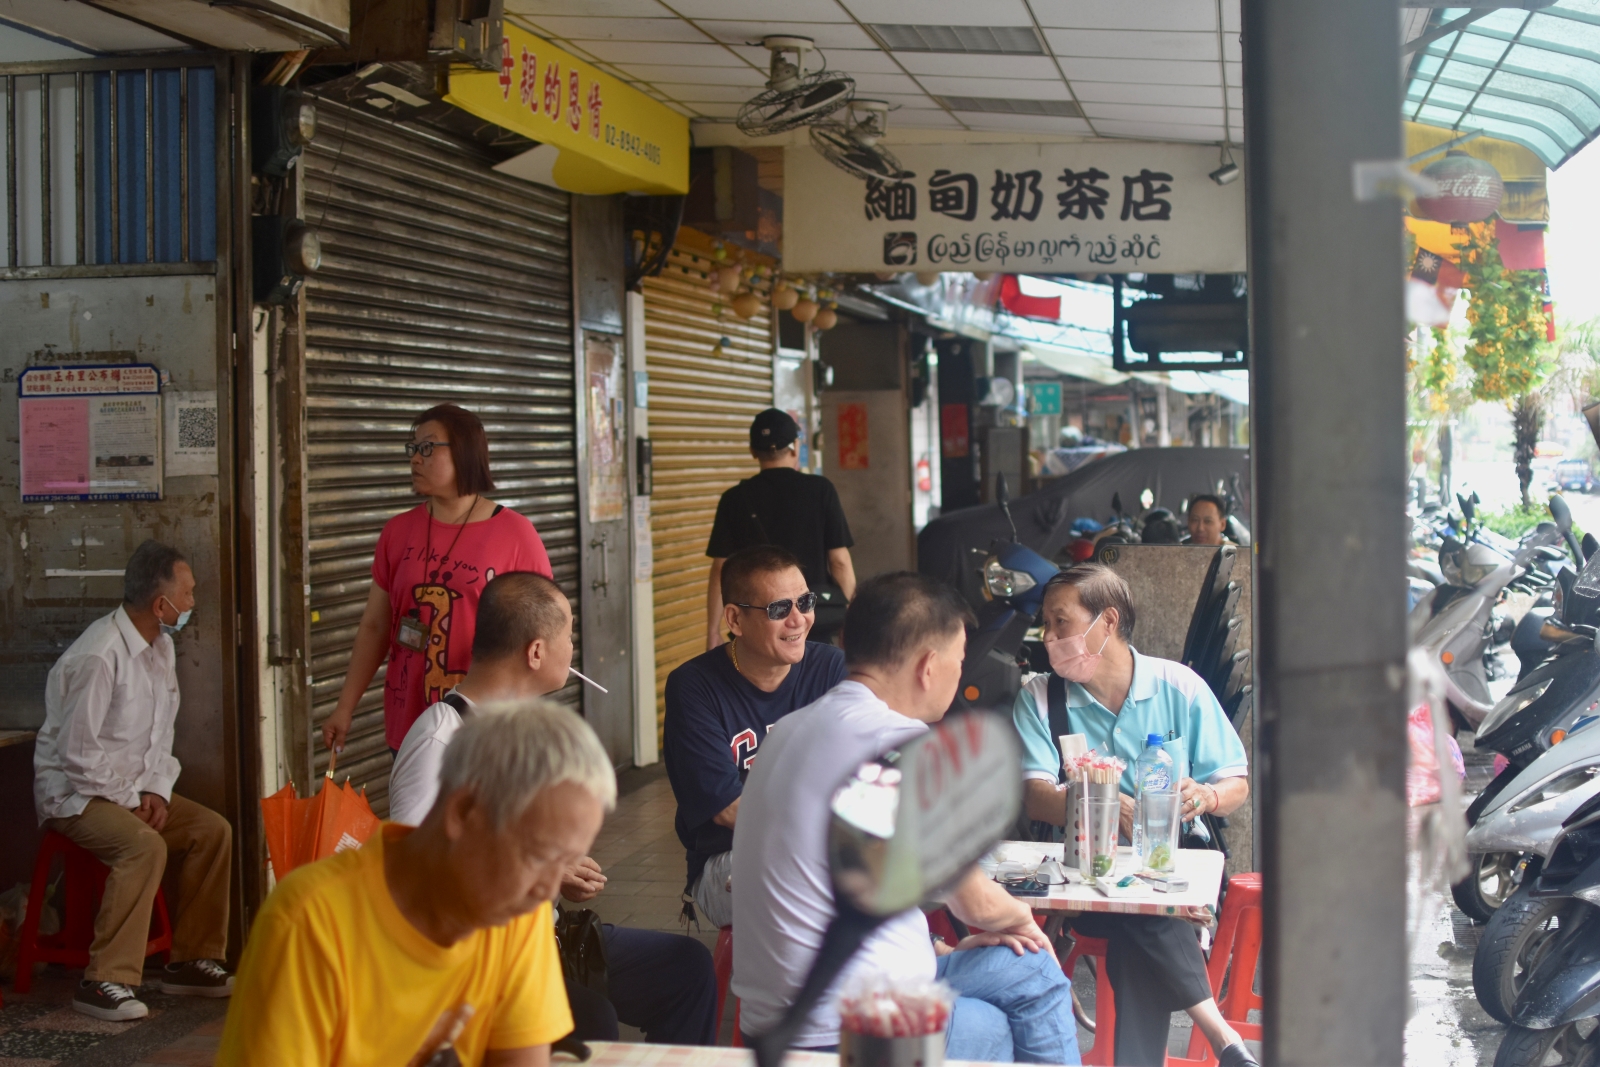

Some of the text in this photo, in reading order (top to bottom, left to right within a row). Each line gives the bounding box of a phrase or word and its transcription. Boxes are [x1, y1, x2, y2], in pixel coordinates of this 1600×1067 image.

[499, 36, 602, 140] 母親的恩情
[864, 167, 1173, 222] 緬甸奶茶店
[403, 546, 479, 574] I like you
[1511, 742, 1533, 757] YAMAHA
